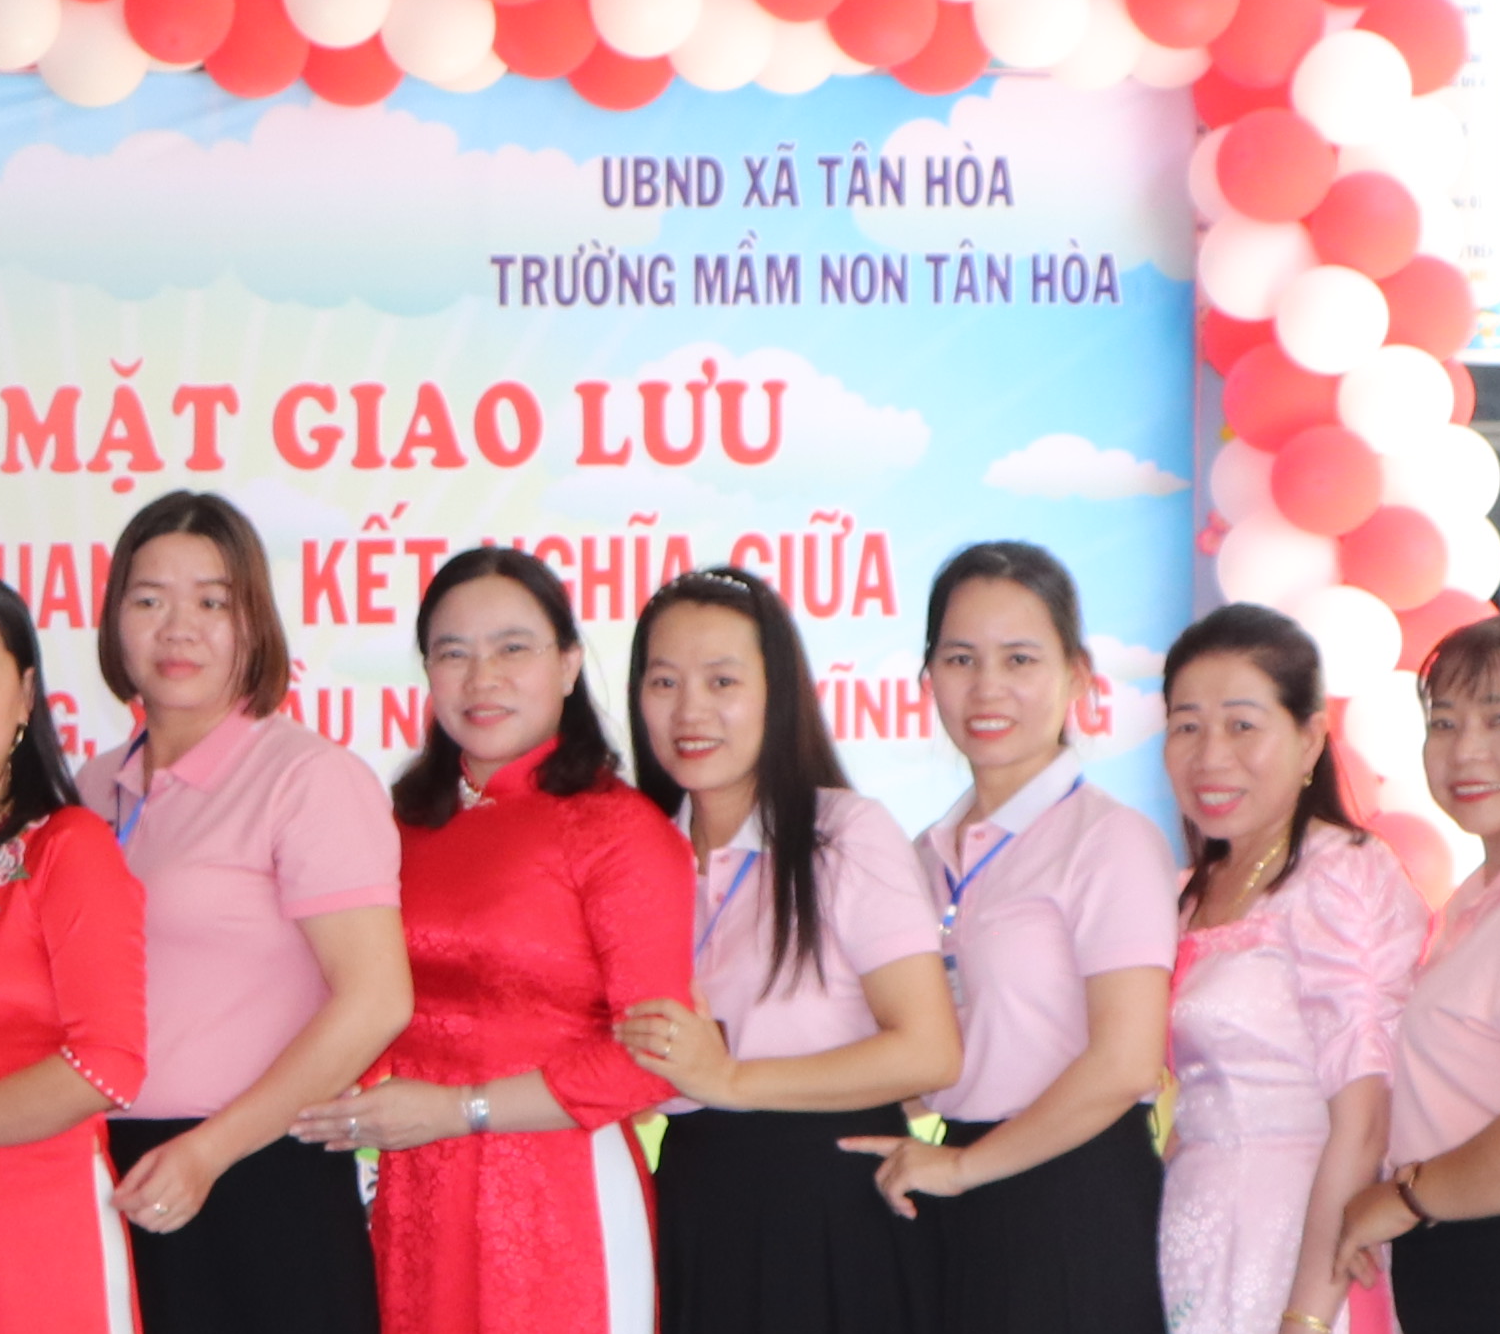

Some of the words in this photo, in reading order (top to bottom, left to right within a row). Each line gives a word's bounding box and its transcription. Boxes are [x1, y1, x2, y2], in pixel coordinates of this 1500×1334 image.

[601, 155, 726, 208] UBND
[741, 142, 801, 208] XÃ
[818, 140, 907, 207] TÂN
[924, 140, 1015, 207] HÒA
[490, 238, 677, 306] TRƯỜNG
[693, 229, 801, 306] MẦM
[820, 252, 909, 305] NON
[925, 238, 1013, 304] TÂN
[1031, 238, 1121, 304] HÒA
[0, 357, 240, 494] MẶT
[272, 380, 544, 471] GIAO
[574, 357, 789, 467] LƯU
[302, 501, 449, 625] KẾT
